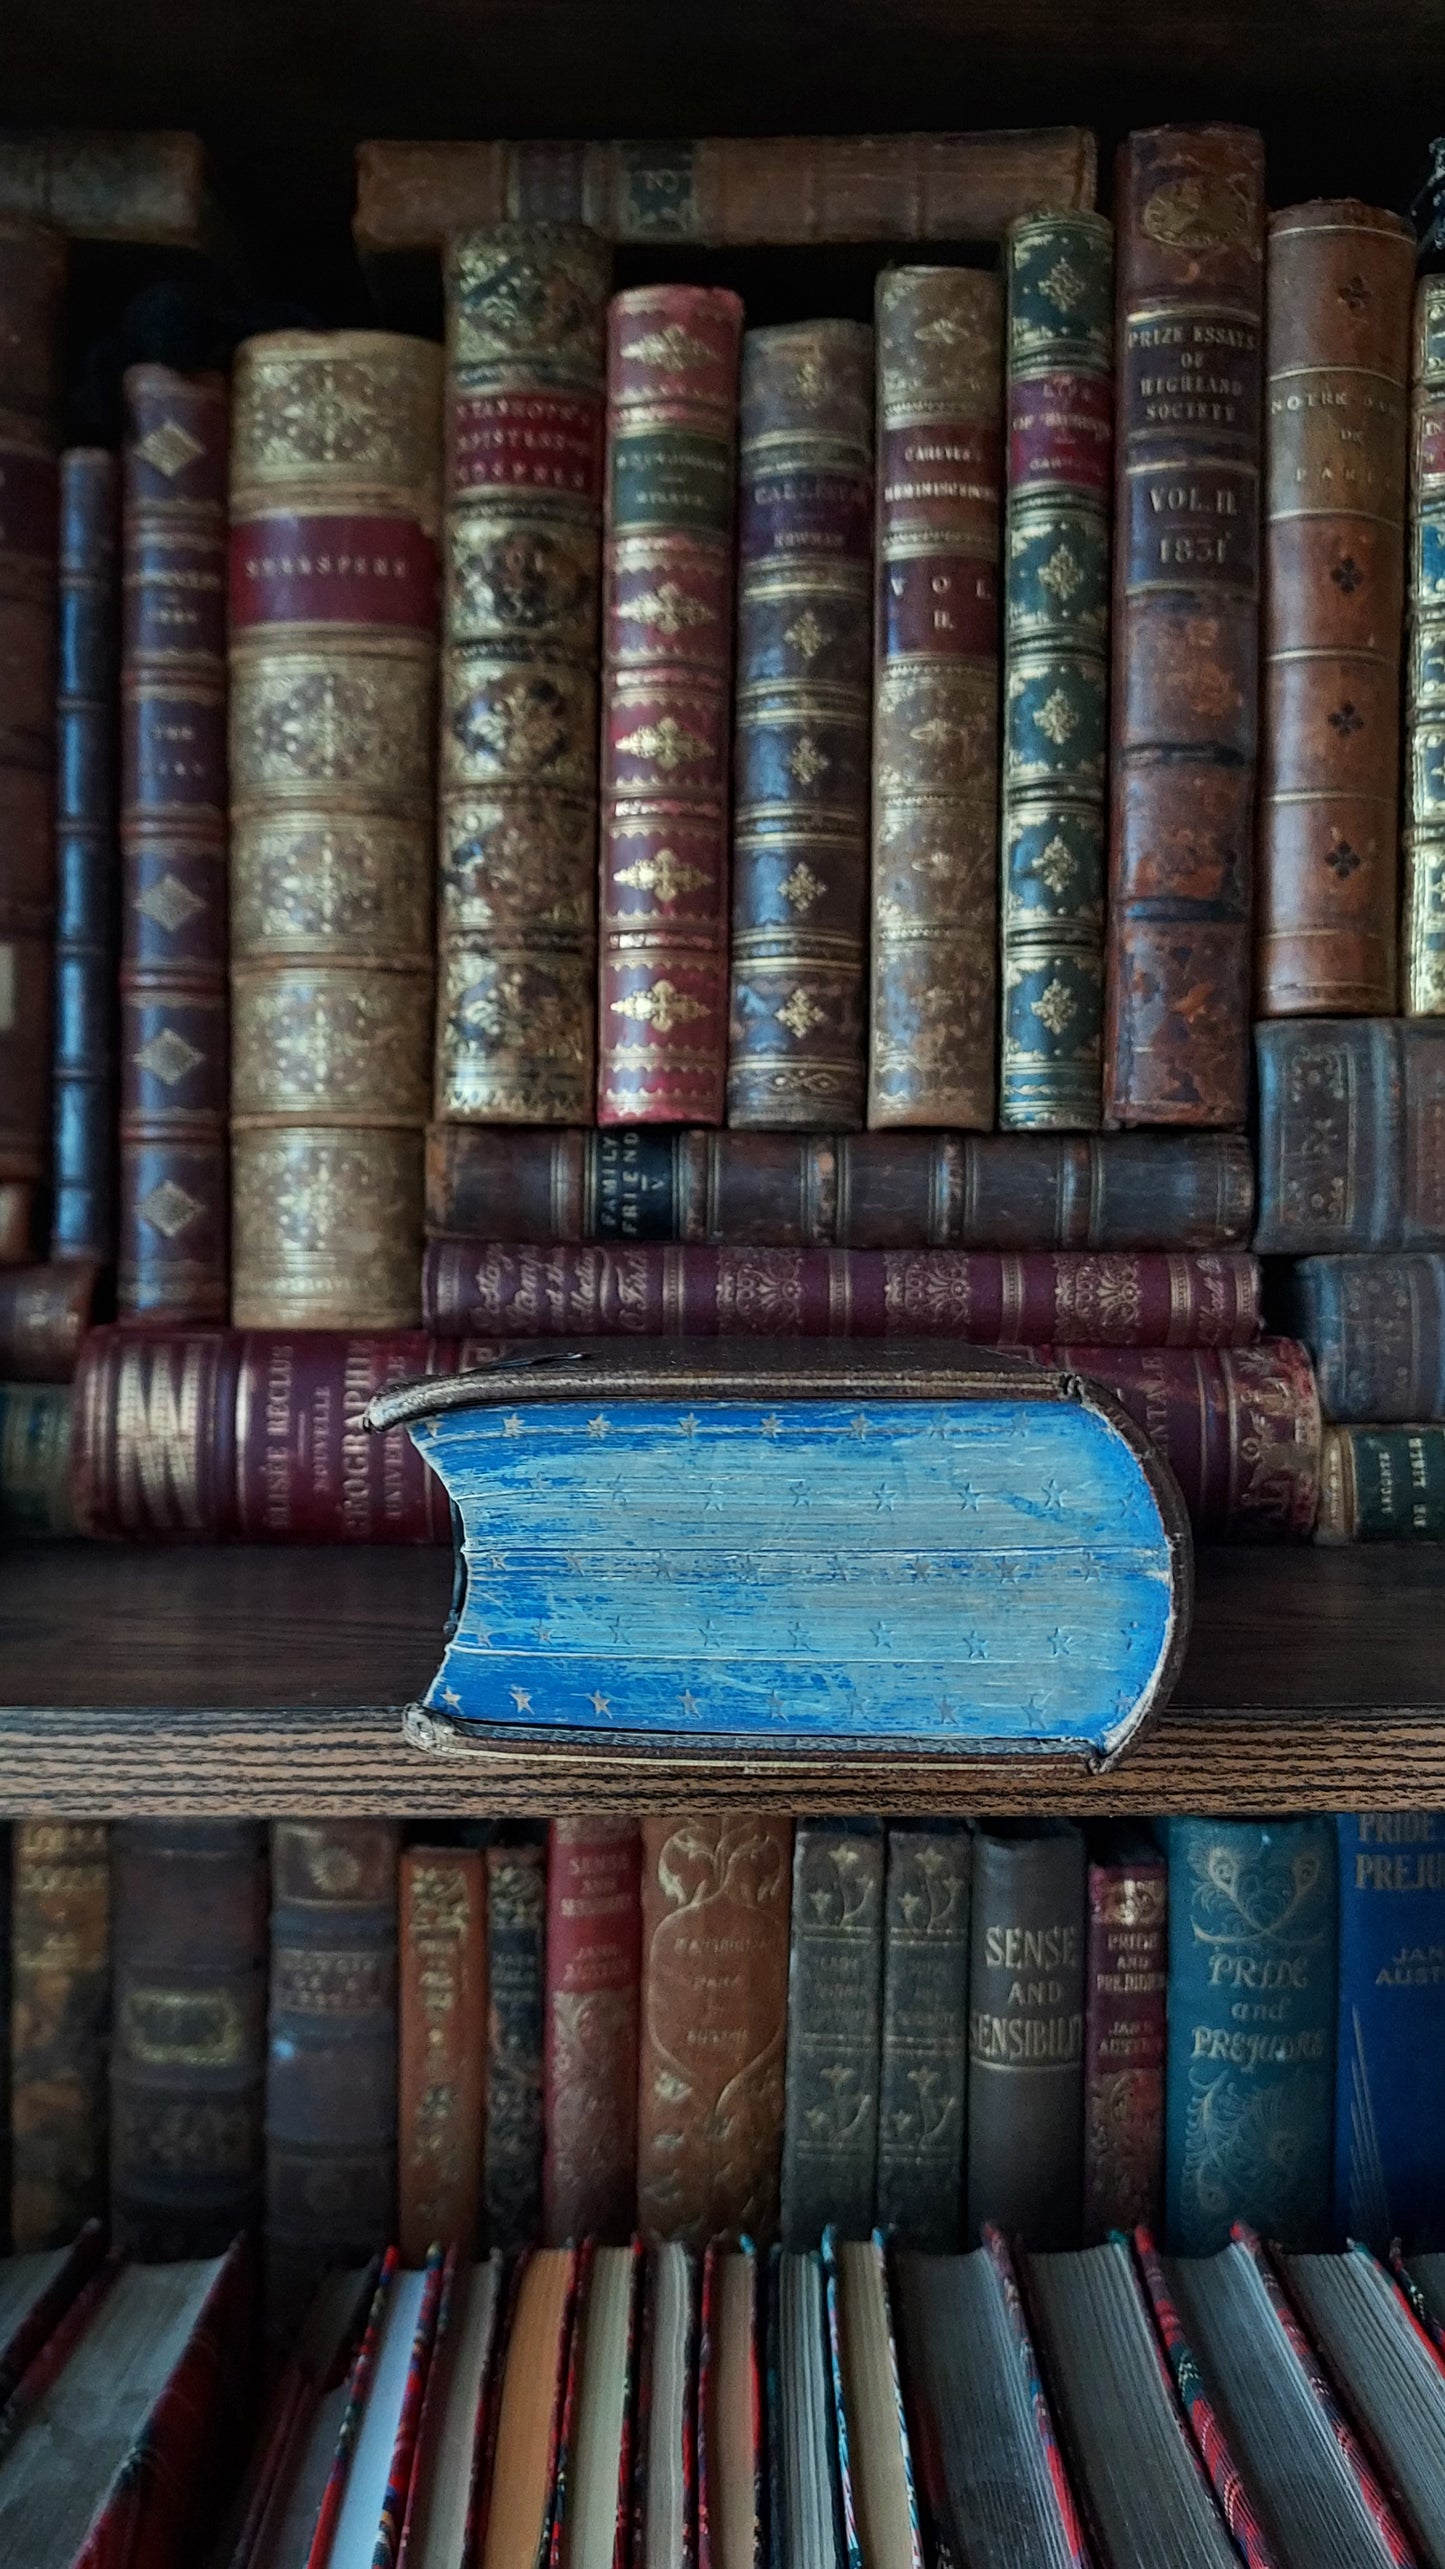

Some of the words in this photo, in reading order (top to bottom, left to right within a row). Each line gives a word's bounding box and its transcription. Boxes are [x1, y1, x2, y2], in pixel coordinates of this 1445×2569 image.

[1128, 326, 1184, 349] PRIZE
[1193, 325, 1255, 350] ESSAYS
[1181, 352, 1204, 368] OF
[1140, 375, 1243, 397] HIGHLAND
[1146, 402, 1236, 423] SOCIETY
[1271, 390, 1348, 415] NOTRE
[1295, 467, 1392, 489] PARI
[602, 1136, 618, 1227] FAMILY
[621, 1131, 640, 1235] FRIEND
[266, 1346, 293, 1437] RECLUS
[313, 1386, 330, 1493] NOUVELLE
[383, 1355, 405, 1521] UNIVERLE
[985, 1925, 1077, 1971] SENSE
[1208, 1952, 1308, 1989] PRIDE
[1008, 1981, 1062, 2006] AND
[1231, 1998, 1290, 2022] and
